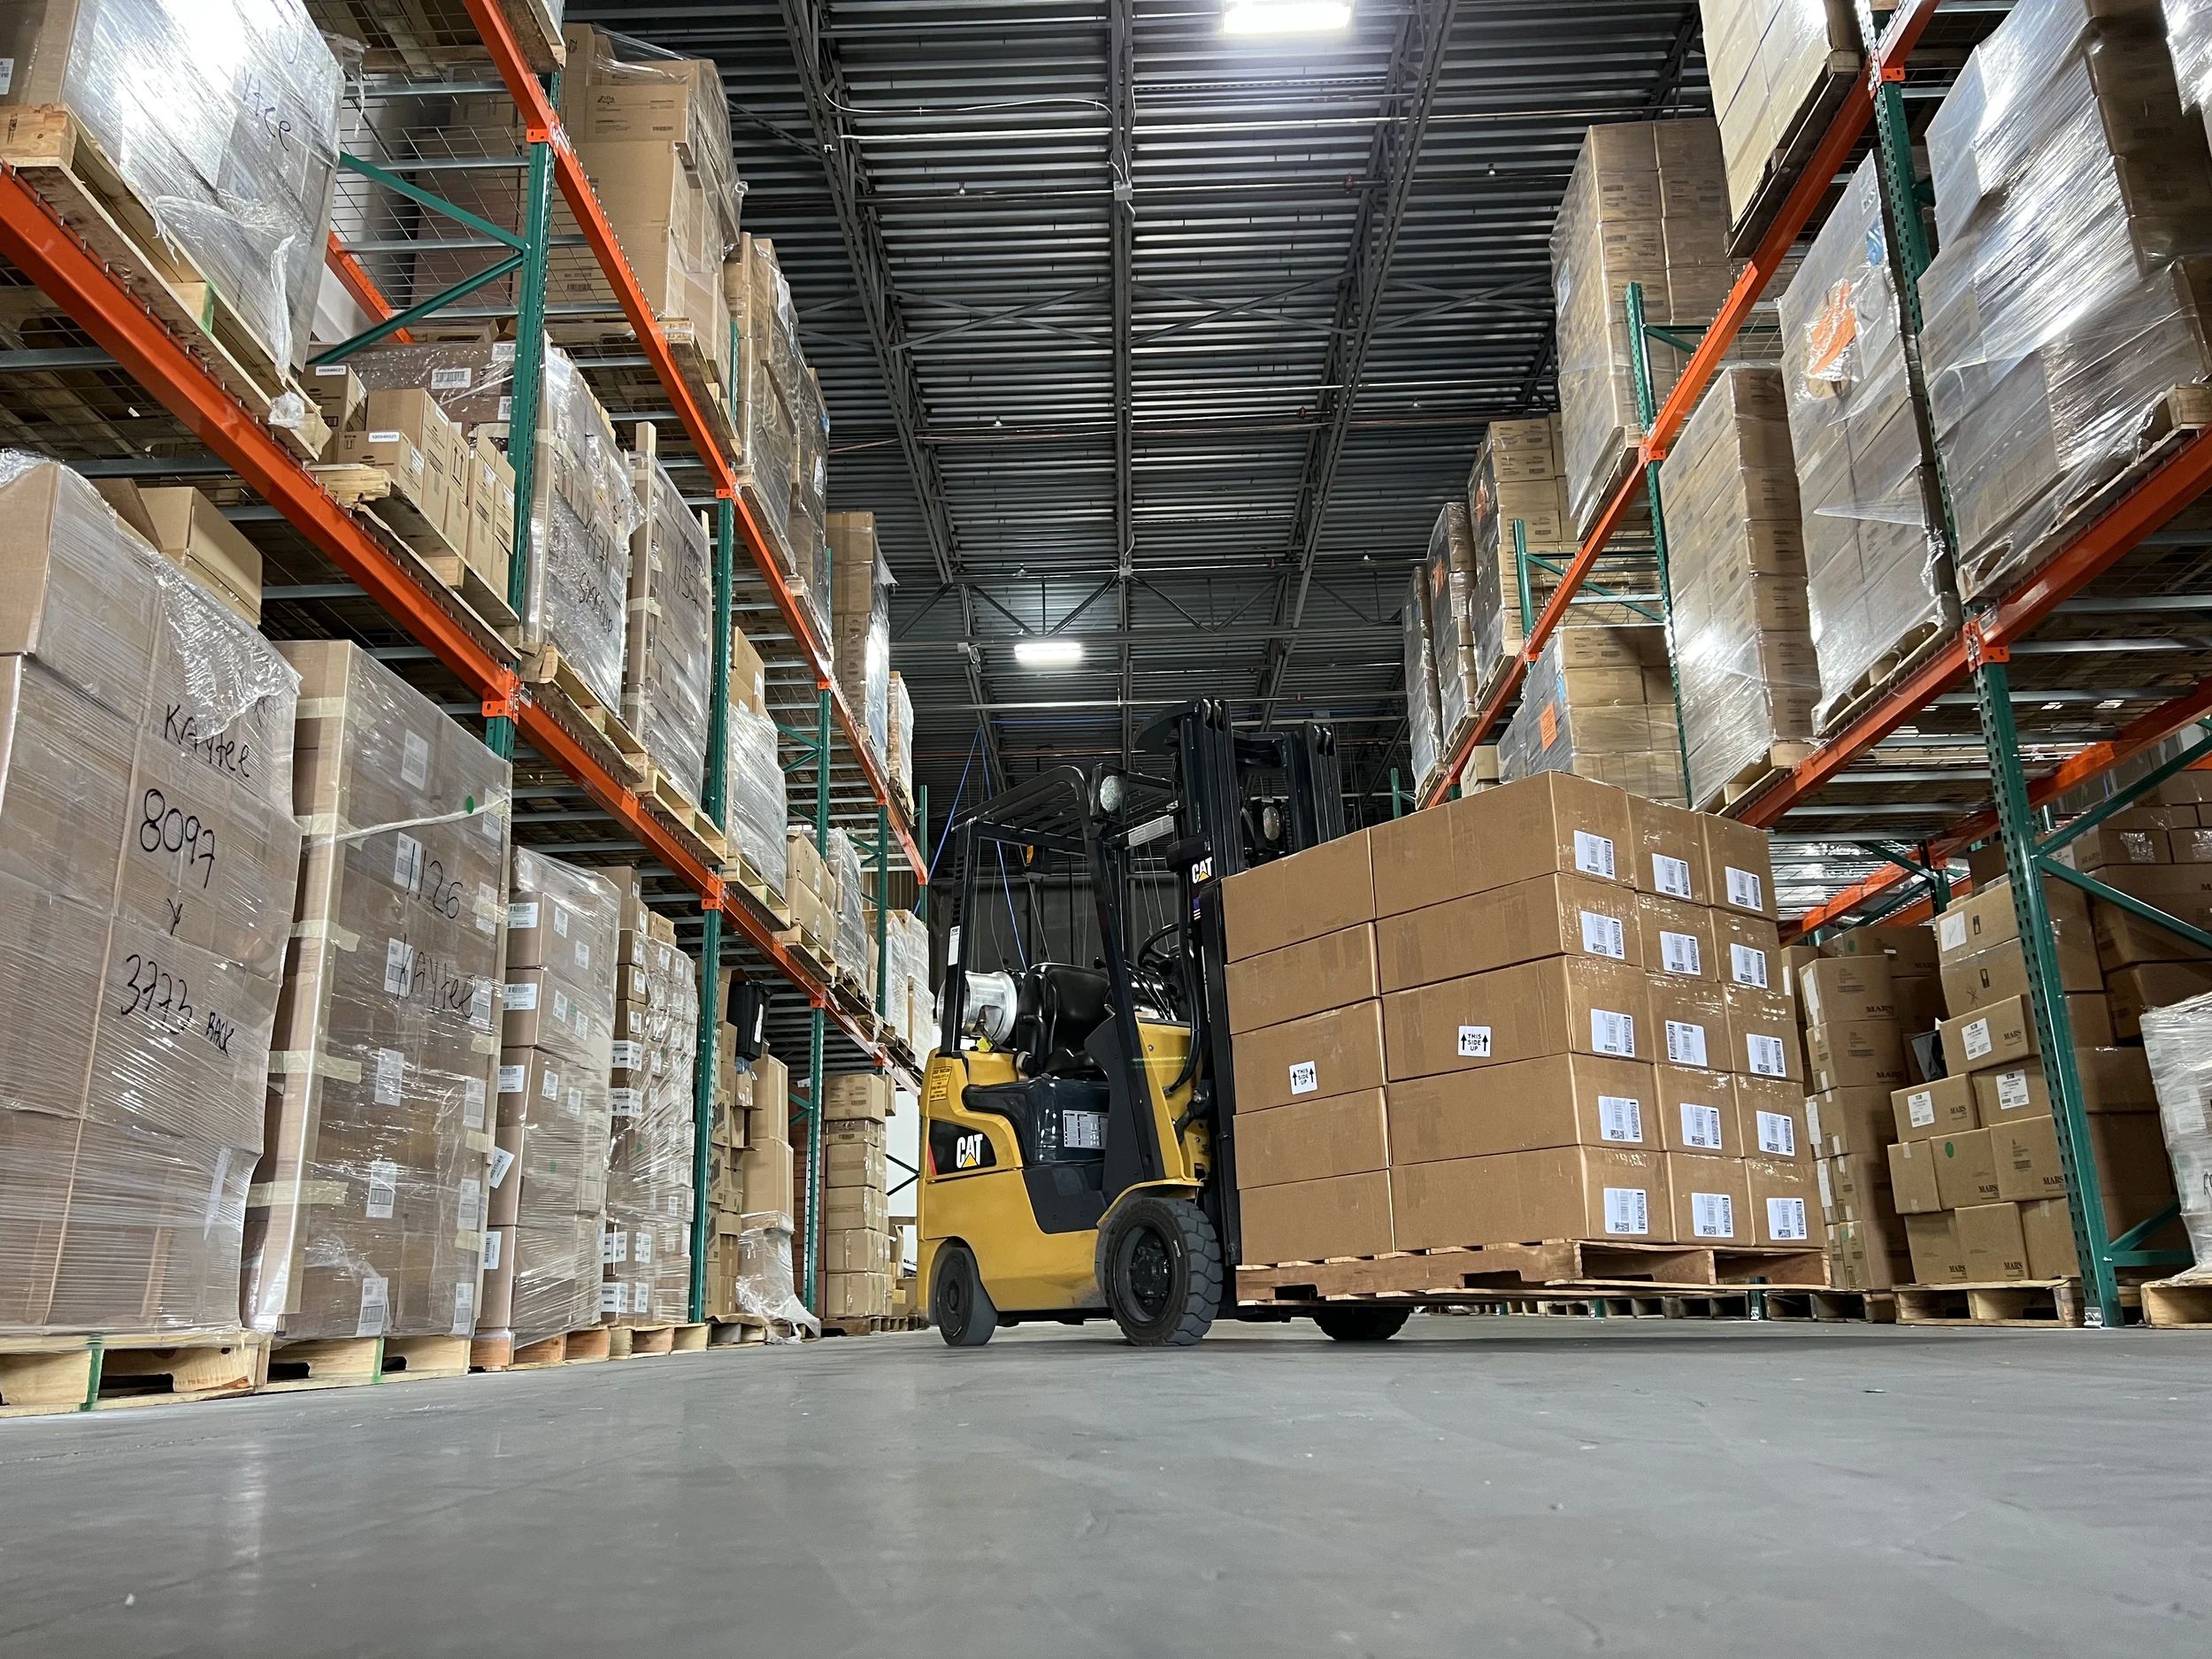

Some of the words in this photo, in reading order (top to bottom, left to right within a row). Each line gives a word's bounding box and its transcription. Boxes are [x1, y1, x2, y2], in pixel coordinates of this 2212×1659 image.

[140, 788, 216, 889] 8097
[1191, 856, 1213, 884] CAT
[406, 842, 464, 919] 1126
[120, 954, 193, 1035] 3773
[2003, 1030, 2023, 1041] MARS
[1949, 1105, 1967, 1114] MARS
[956, 1133, 984, 1169] CAT
[2042, 1175, 2064, 1186] MARS
[1978, 1184, 1999, 1194] MARS
[1948, 1264, 1966, 1273] MARS
[2003, 1261, 2024, 1271] MARS
